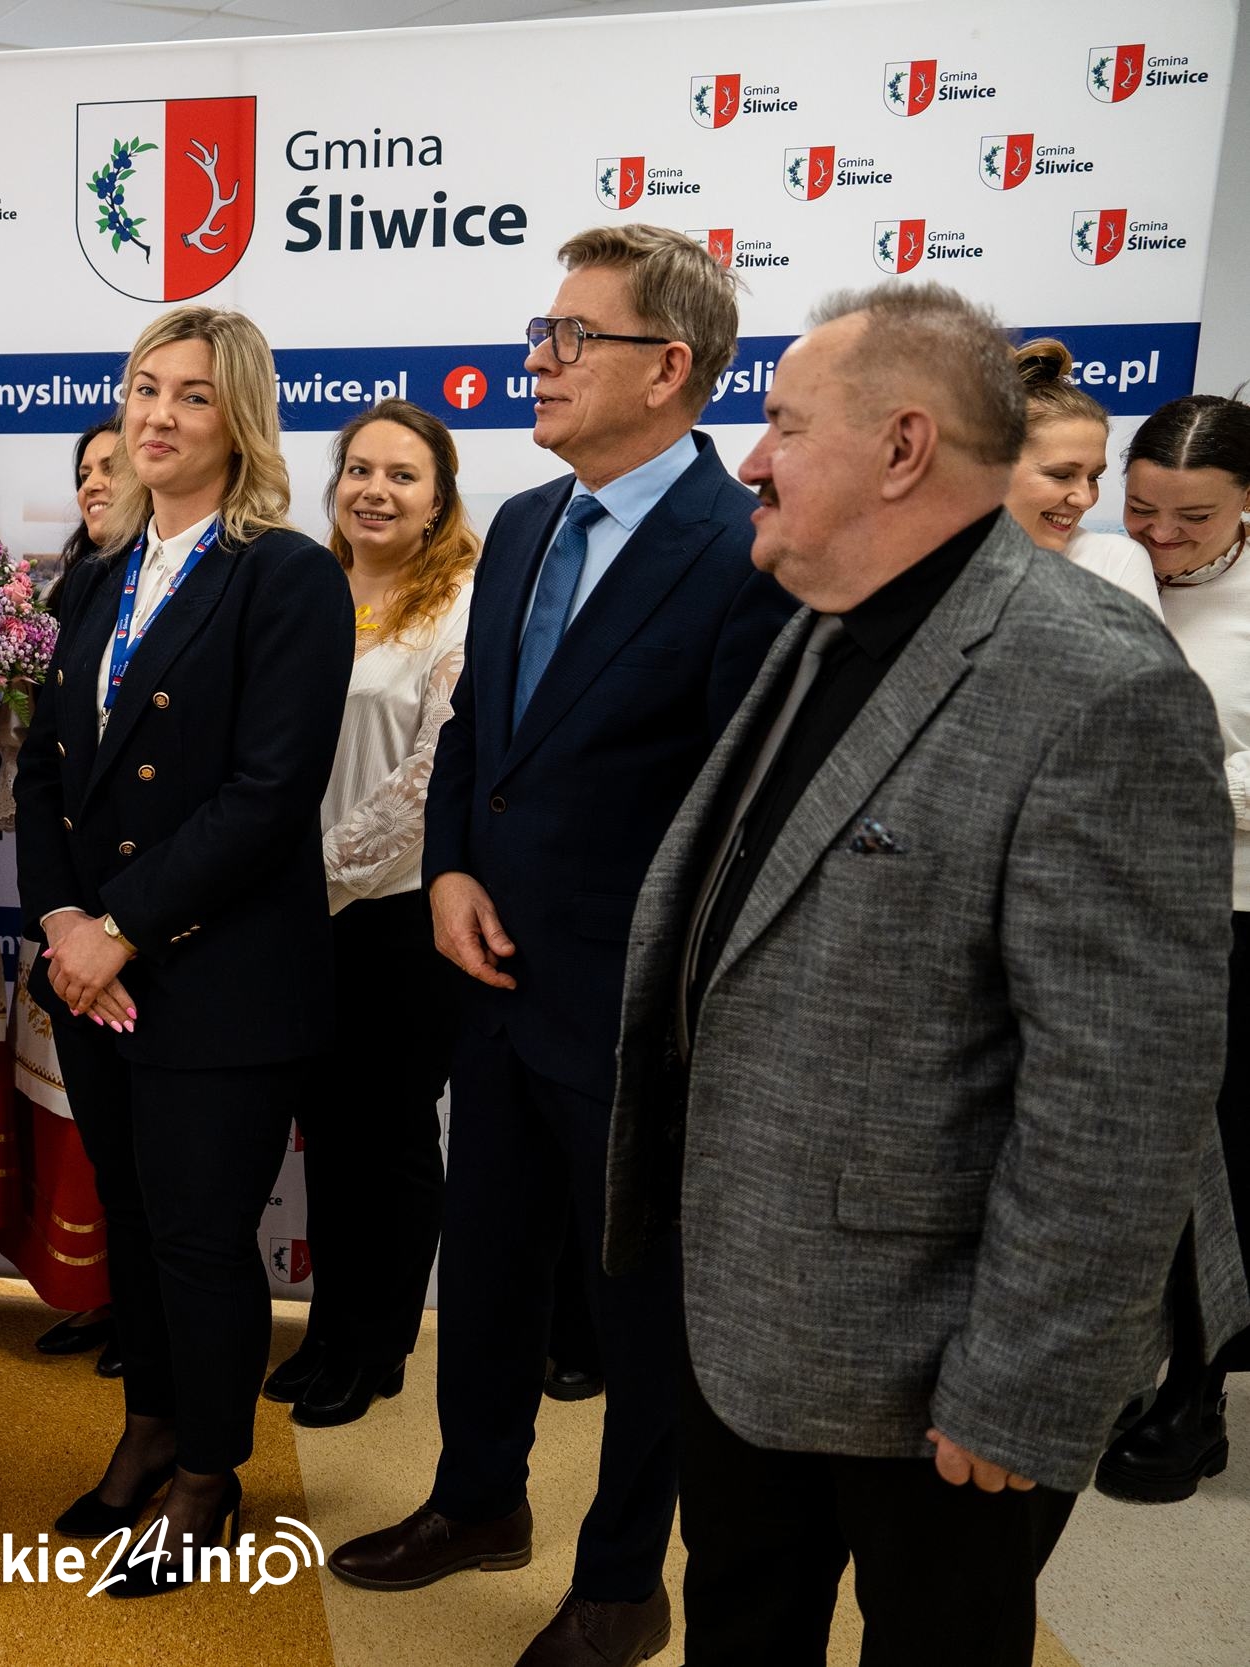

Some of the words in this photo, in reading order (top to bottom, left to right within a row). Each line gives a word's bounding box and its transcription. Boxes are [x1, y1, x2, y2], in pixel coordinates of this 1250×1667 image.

[1148, 55, 1188, 68] Gmina
[940, 70, 978, 83] Gmina
[1146, 69, 1208, 86] Śliwice
[744, 84, 780, 97] Gmina
[938, 84, 996, 101] Śliwice
[743, 98, 798, 114] Śliwice
[286, 128, 443, 171] Gmina
[1037, 144, 1075, 157] Gmina
[838, 157, 874, 168] Gmina
[1035, 159, 1093, 175] Śliwice
[648, 167, 683, 178] Gmina
[837, 170, 892, 187] Śliwice
[648, 180, 700, 196] Śliwice
[285, 185, 527, 253] Śliwice
[1130, 220, 1168, 234] Gmina
[928, 230, 965, 242] Gmina
[1127, 234, 1186, 251] Śliwice
[736, 239, 772, 250] Gmina
[927, 244, 983, 260] Śliwice
[736, 253, 789, 268] Śliwice
[275, 371, 408, 408] iwice.pl
